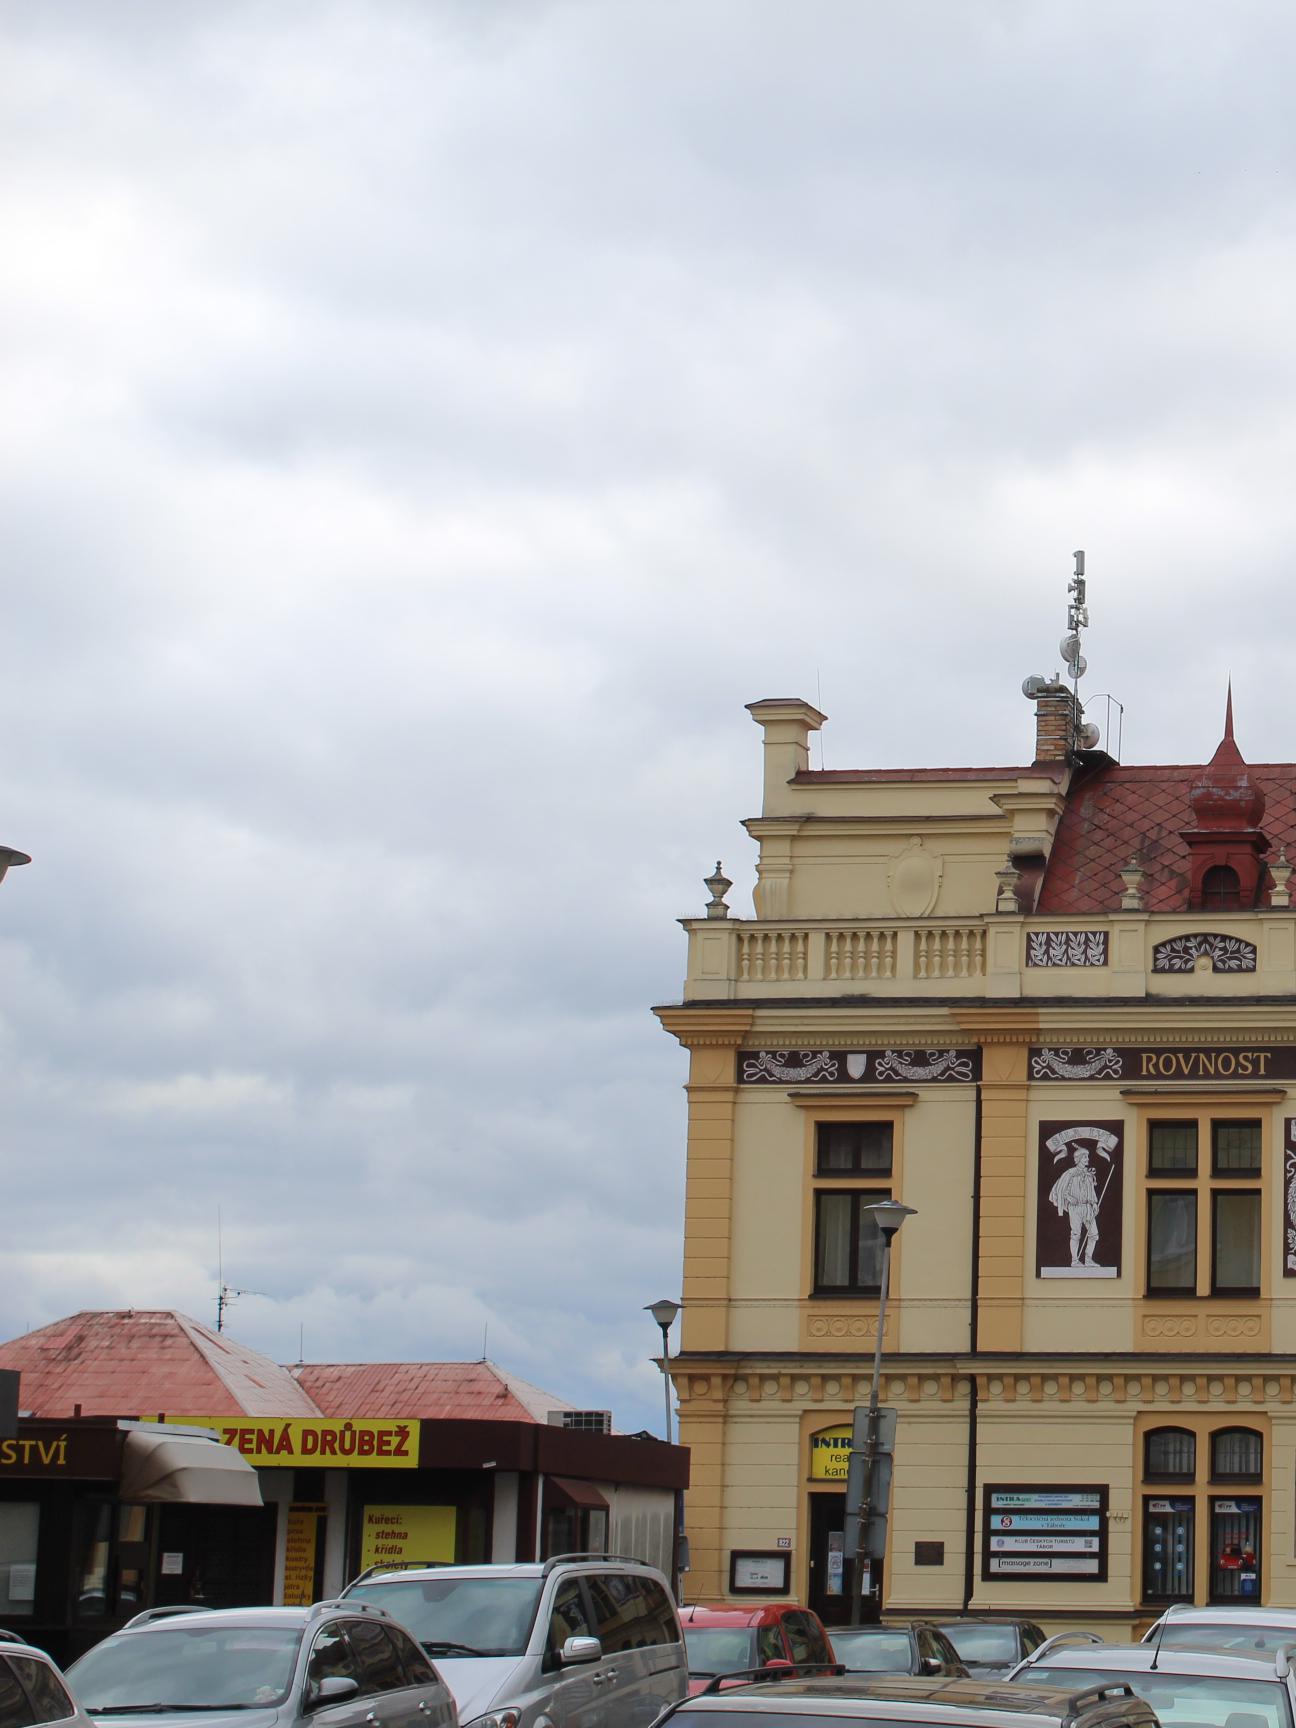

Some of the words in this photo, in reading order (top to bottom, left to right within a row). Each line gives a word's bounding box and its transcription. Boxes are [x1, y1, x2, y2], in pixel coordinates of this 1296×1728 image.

[1140, 1052, 1272, 1075] ROVNOST
[0, 1433, 67, 1465] STVÍ
[301, 1421, 411, 1457] DRŮBEŽ
[824, 1466, 849, 1476] kan
[375, 1530, 408, 1540] stehna
